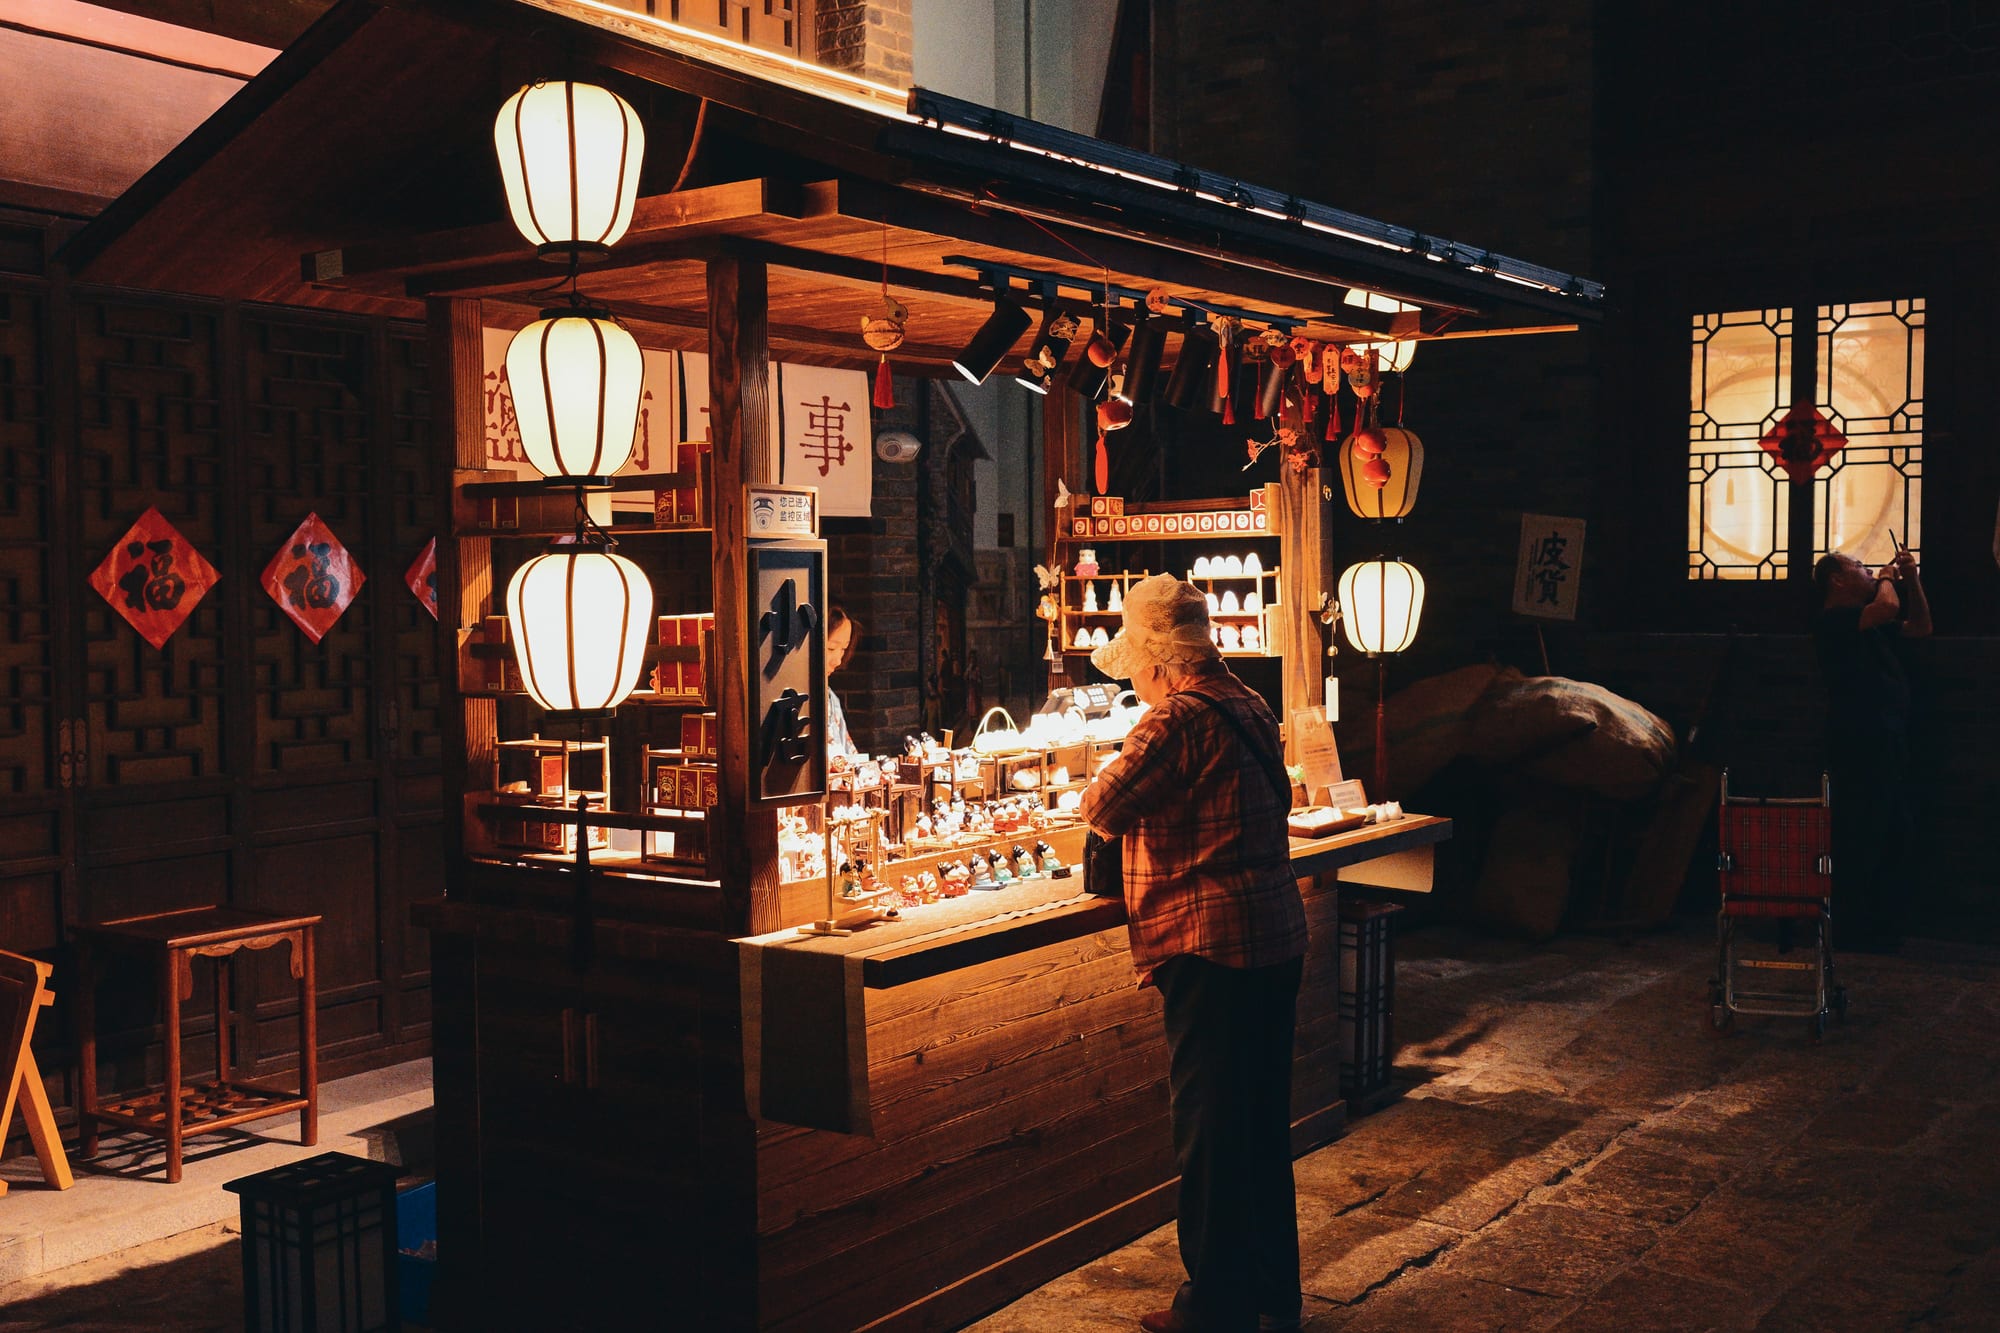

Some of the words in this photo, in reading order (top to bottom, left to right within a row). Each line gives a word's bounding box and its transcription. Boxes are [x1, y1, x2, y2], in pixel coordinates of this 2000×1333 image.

[800, 395, 854, 477] 事
[779, 496, 810, 508] 您已进入
[119, 539, 185, 613] 福
[284, 542, 341, 611] 福
[1537, 530, 1571, 605] 皮貨
